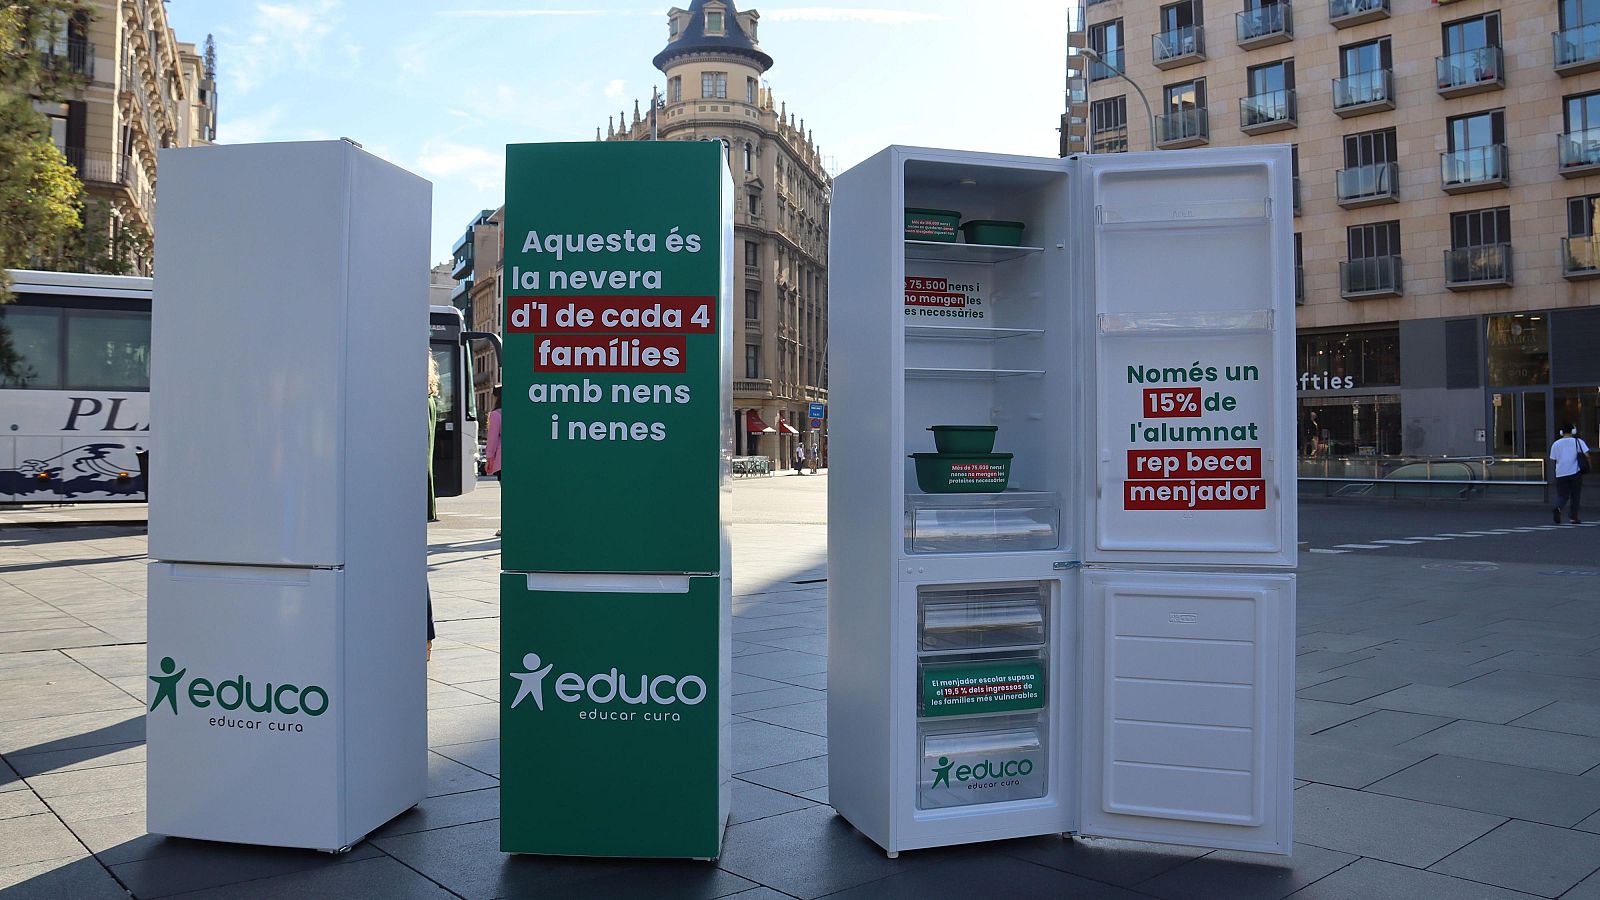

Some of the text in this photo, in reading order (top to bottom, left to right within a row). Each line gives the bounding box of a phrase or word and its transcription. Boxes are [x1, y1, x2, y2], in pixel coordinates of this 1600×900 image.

[522, 226, 701, 260] Aquesta és
[512, 266, 662, 289] la nevera
[910, 280, 946, 290] 75.500
[948, 283, 974, 292] nens
[976, 283, 980, 292] i
[920, 296, 964, 306] mengen
[966, 296, 982, 305] les
[511, 302, 710, 328] d'1 de cada 4
[920, 308, 984, 318] necessàries
[539, 338, 680, 366] famílies
[1127, 361, 1259, 383] Només un
[1297, 371, 1354, 390] fties
[528, 379, 690, 404] amb nens
[1149, 392, 1237, 412] 15% de
[551, 414, 666, 441] i nenes
[1130, 422, 1258, 442] l'alumnat
[1136, 452, 1252, 478] rep beca
[1130, 480, 1260, 507] menjador
[555, 668, 707, 705] educo
[940, 678, 978, 687] menjador
[978, 676, 1006, 684] escolar
[1008, 674, 1035, 682] suposa
[944, 688, 960, 696] 19,5
[968, 686, 985, 694] dels
[986, 682, 1022, 694] ingressos
[188, 674, 329, 716] educo
[944, 696, 975, 705] famílies
[976, 694, 993, 702] més
[994, 691, 1038, 701] vulnerables
[210, 716, 304, 732] educar cura
[579, 708, 680, 722] educar cura
[956, 758, 1033, 782] educo
[968, 779, 1020, 790] educar cura
